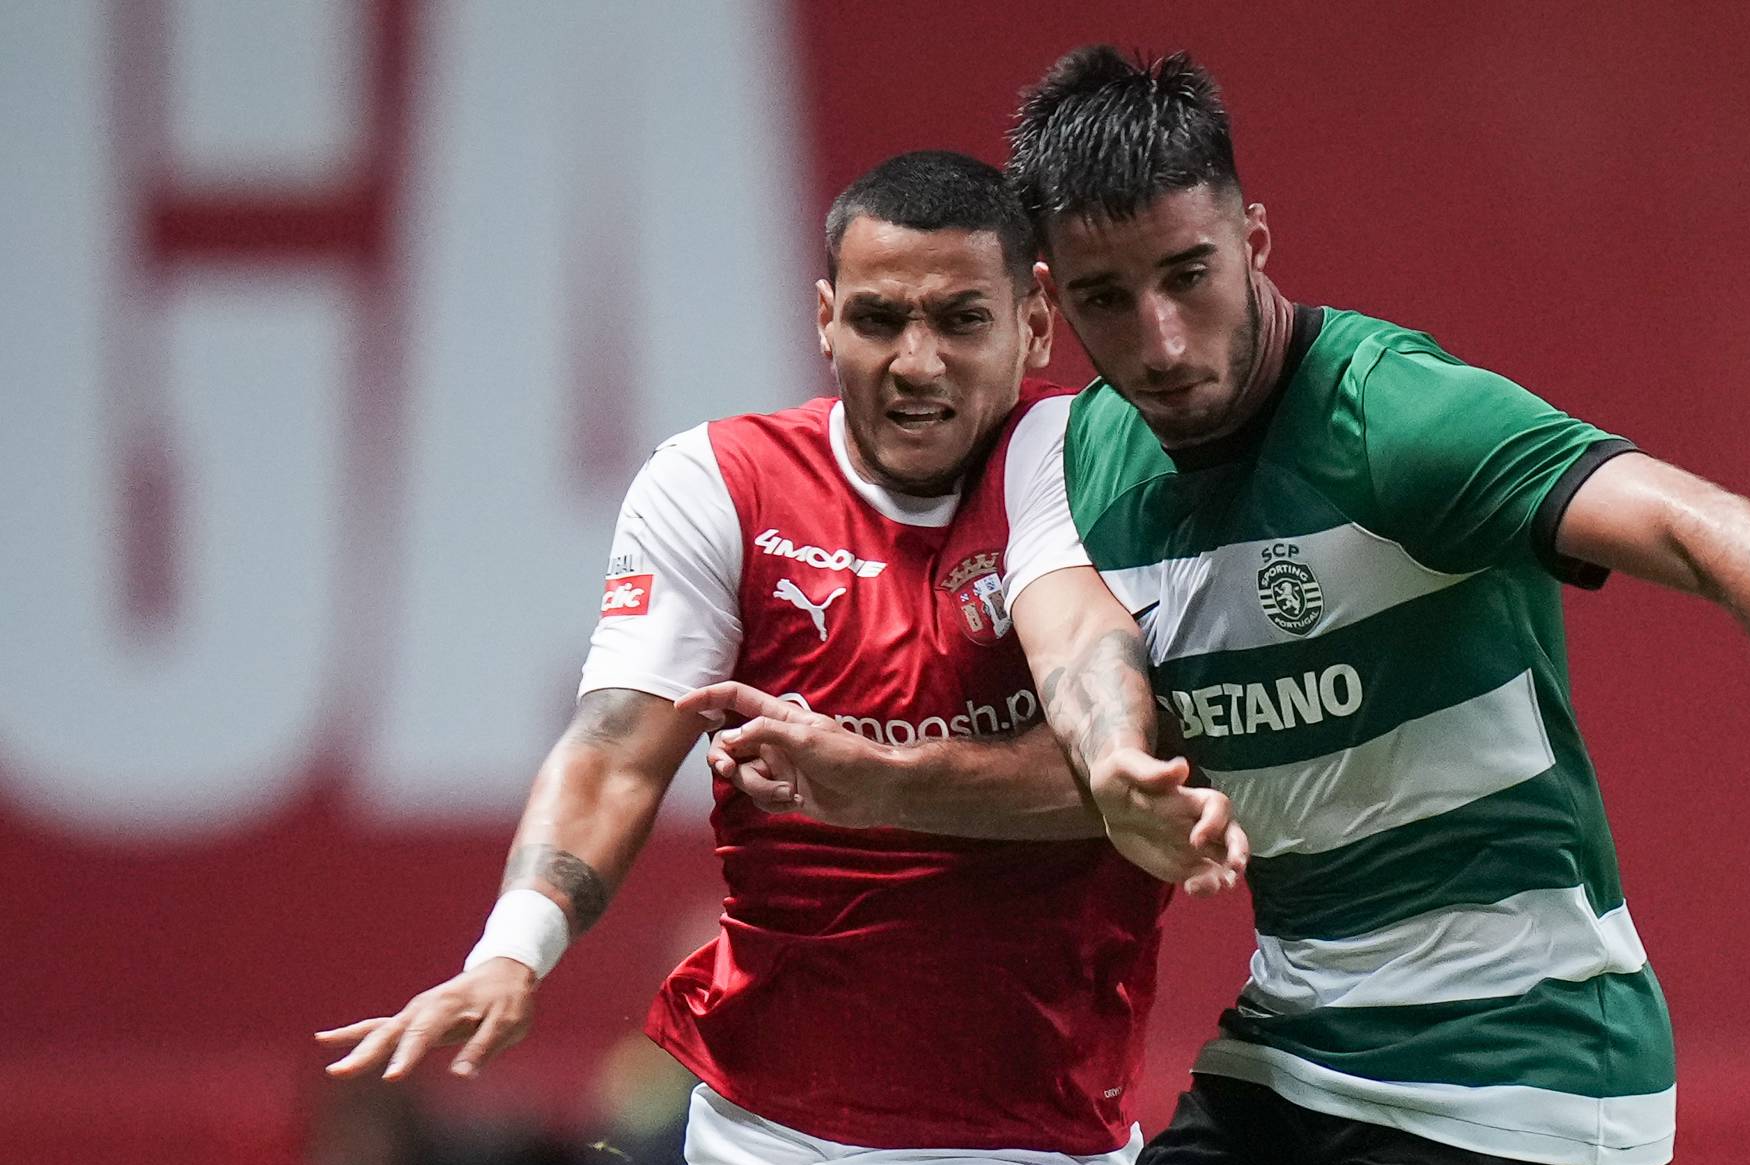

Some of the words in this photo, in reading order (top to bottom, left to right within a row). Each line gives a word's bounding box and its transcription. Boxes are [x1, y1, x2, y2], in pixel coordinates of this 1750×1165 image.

[1261, 543, 1300, 563] SCP
[1261, 564, 1309, 587] SPORTING
[1274, 610, 1319, 629] PORTUGAL
[1172, 663, 1363, 739] BETANO
